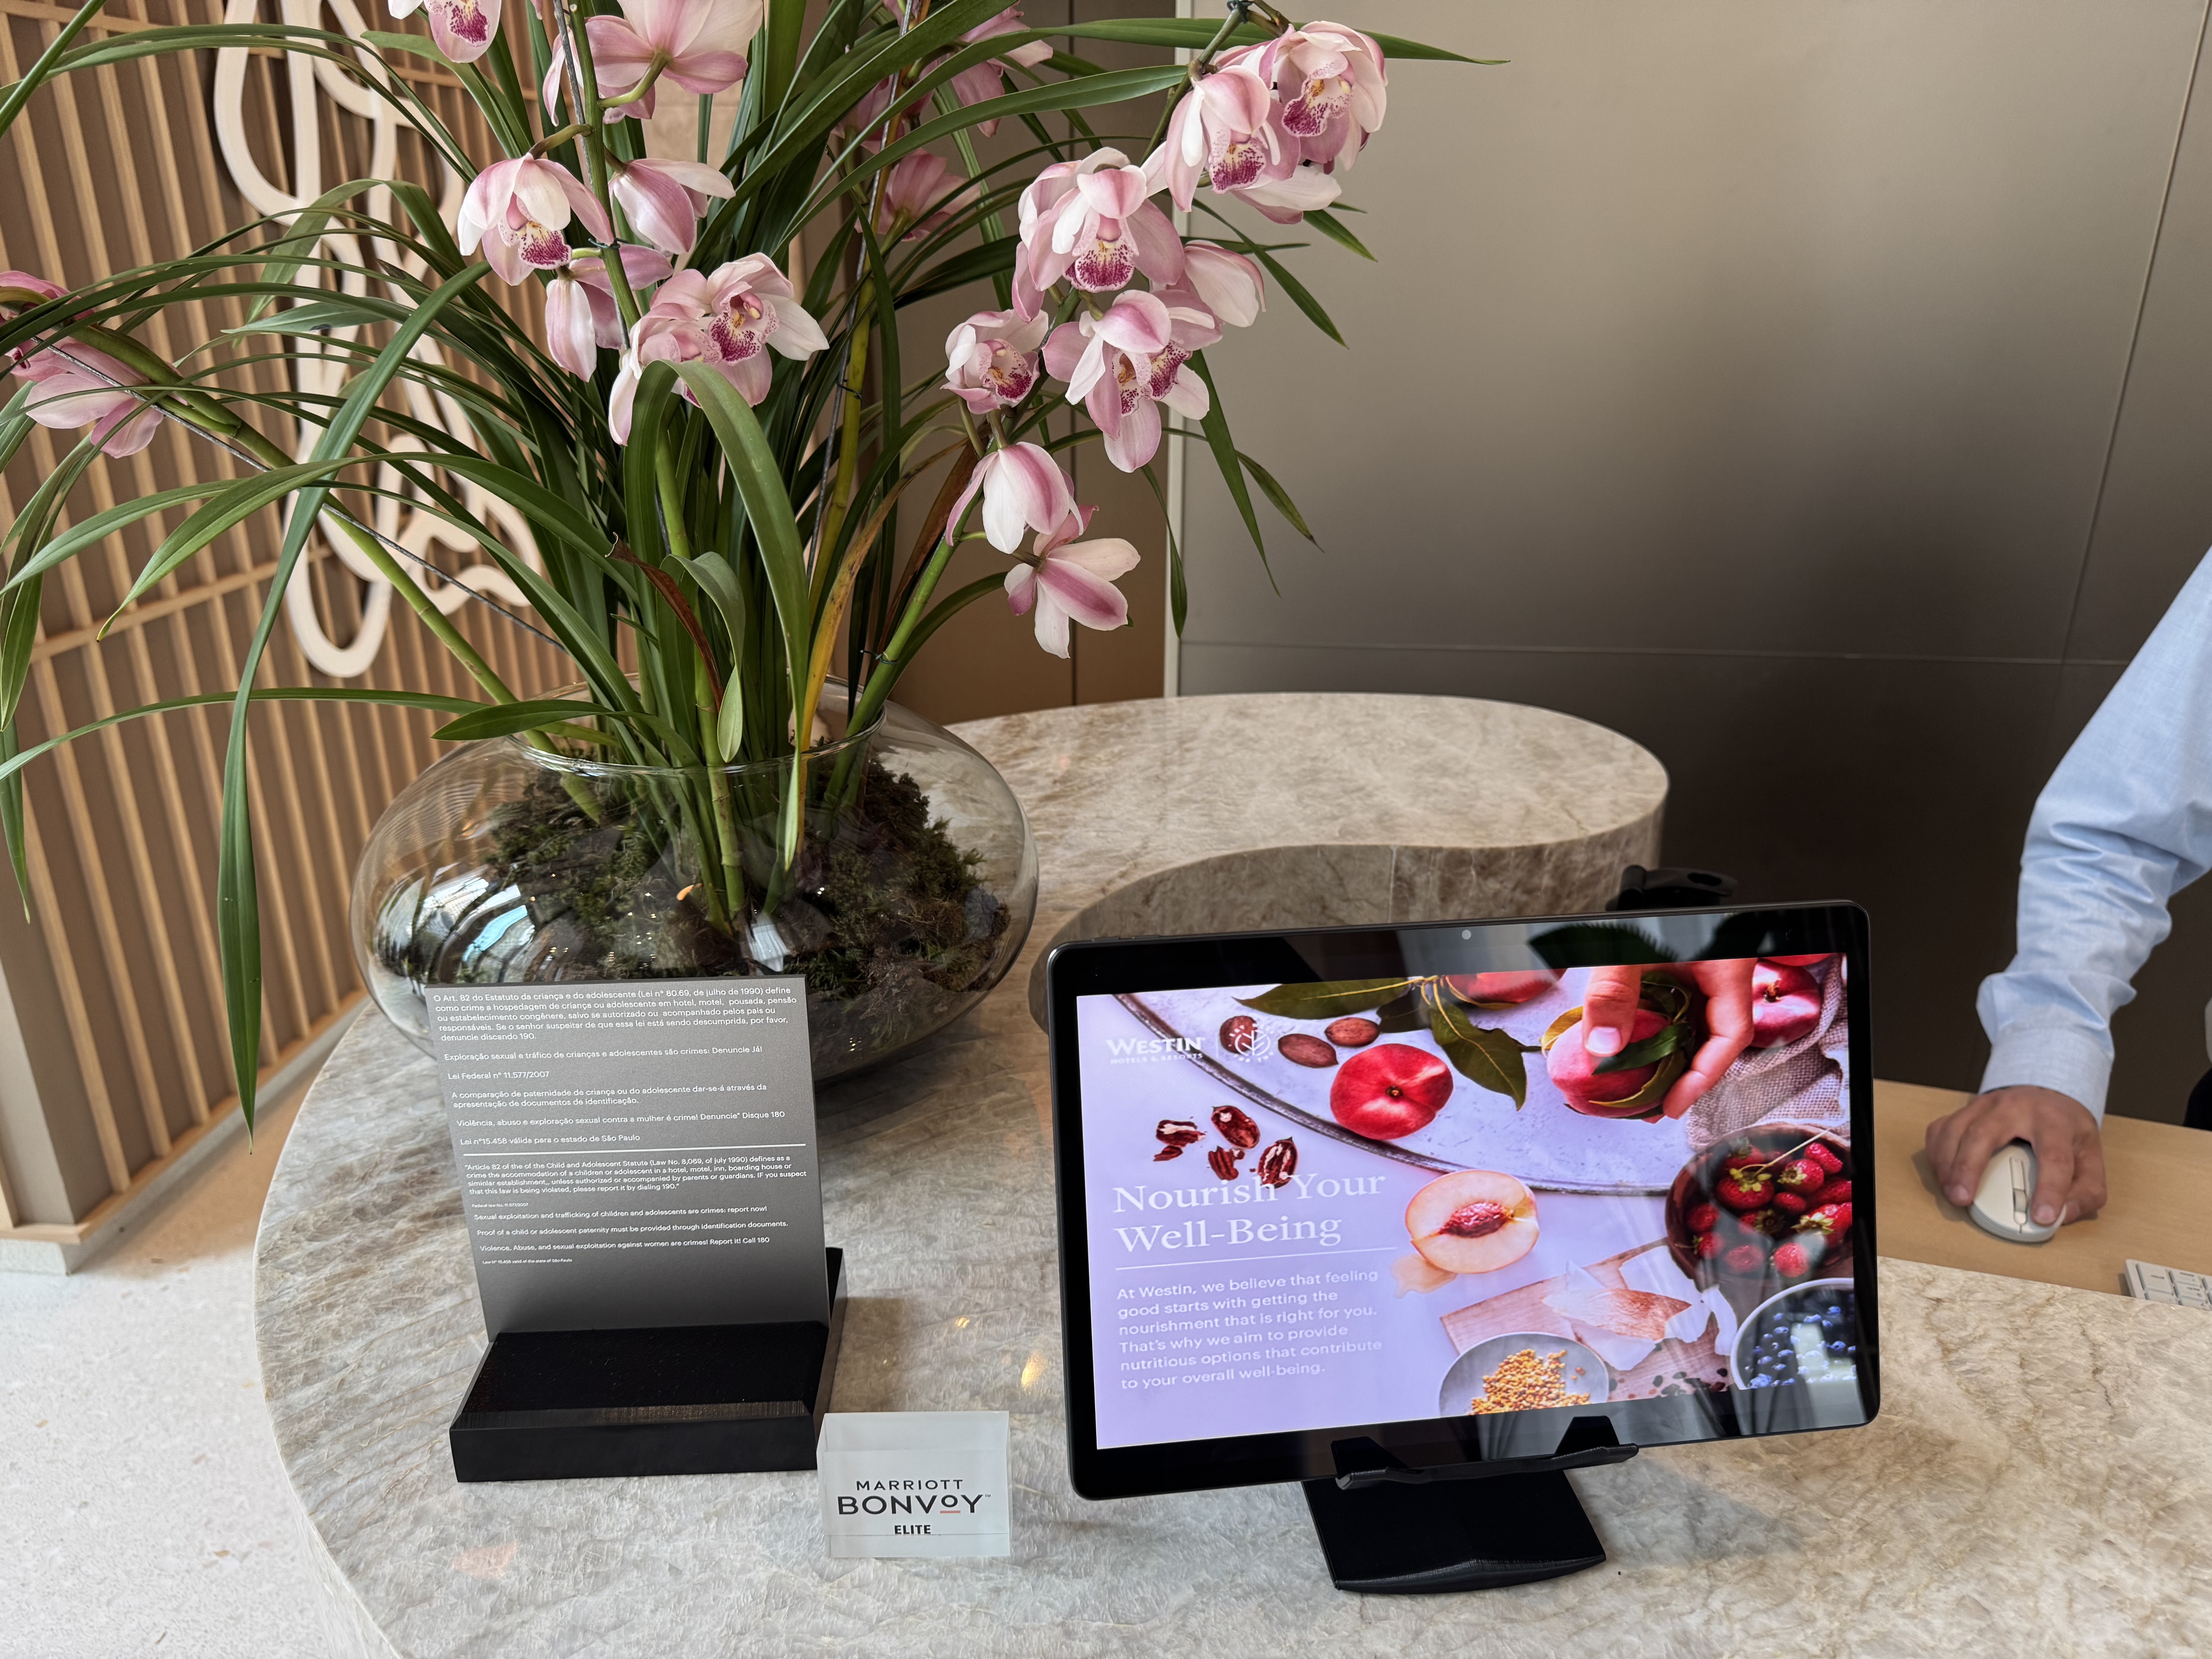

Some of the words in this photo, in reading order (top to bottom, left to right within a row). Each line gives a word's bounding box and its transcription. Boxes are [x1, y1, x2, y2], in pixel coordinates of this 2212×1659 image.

[638, 990, 653, 998] (Lei
[706, 988, 726, 997] julho
[740, 987, 763, 995] 1990)
[493, 1003, 547, 1011] hospedagem
[562, 1002, 592, 1010] criança
[729, 997, 765, 1006] pousada,
[768, 996, 797, 1005] pensão
[444, 1053, 489, 1061] Exploração
[566, 1051, 600, 1059] crianças
[503, 1071, 550, 1079] 11.577/2007
[523, 1089, 572, 1098] paternidade
[586, 1088, 615, 1096] criança
[530, 1118, 574, 1126] exploração
[1113, 1175, 1279, 1212] Nourish
[1287, 1174, 1386, 1199] Your
[1113, 1215, 1342, 1252] Well-Being
[1117, 1288, 1135, 1300] At
[1139, 1284, 1197, 1298] Westin,
[1201, 1283, 1224, 1293] we
[1229, 1278, 1286, 1290] believe
[1290, 1274, 1321, 1286] that
[1325, 1271, 1378, 1283] feeling
[1118, 1303, 1159, 1320] good
[1164, 1302, 1209, 1314] starts
[1212, 1297, 1246, 1309] with
[1251, 1293, 1307, 1309] getting
[1312, 1290, 1338, 1302] the
[1119, 1317, 1220, 1336] nourishment
[1224, 1315, 1256, 1327] that
[1260, 1313, 1273, 1324] is
[1276, 1309, 1314, 1324] right
[1318, 1307, 1340, 1319] for
[1344, 1307, 1377, 1319] you.
[1170, 1337, 1202, 1349] why
[1206, 1336, 1230, 1346] we
[1234, 1332, 1262, 1344] aim
[1267, 1331, 1284, 1341] to
[1288, 1325, 1348, 1341] provide
[1121, 1357, 1197, 1371] nutritious
[1201, 1351, 1261, 1365] options
[1265, 1348, 1296, 1359] that
[1300, 1341, 1382, 1356] contribute
[1121, 1379, 1139, 1389] to
[1142, 1376, 1178, 1389] your
[1182, 1368, 1234, 1384] overall
[1239, 1363, 1325, 1379] well-being.
[856, 1479, 963, 1491] MARRIOTT
[894, 1525, 931, 1535] ELITE
